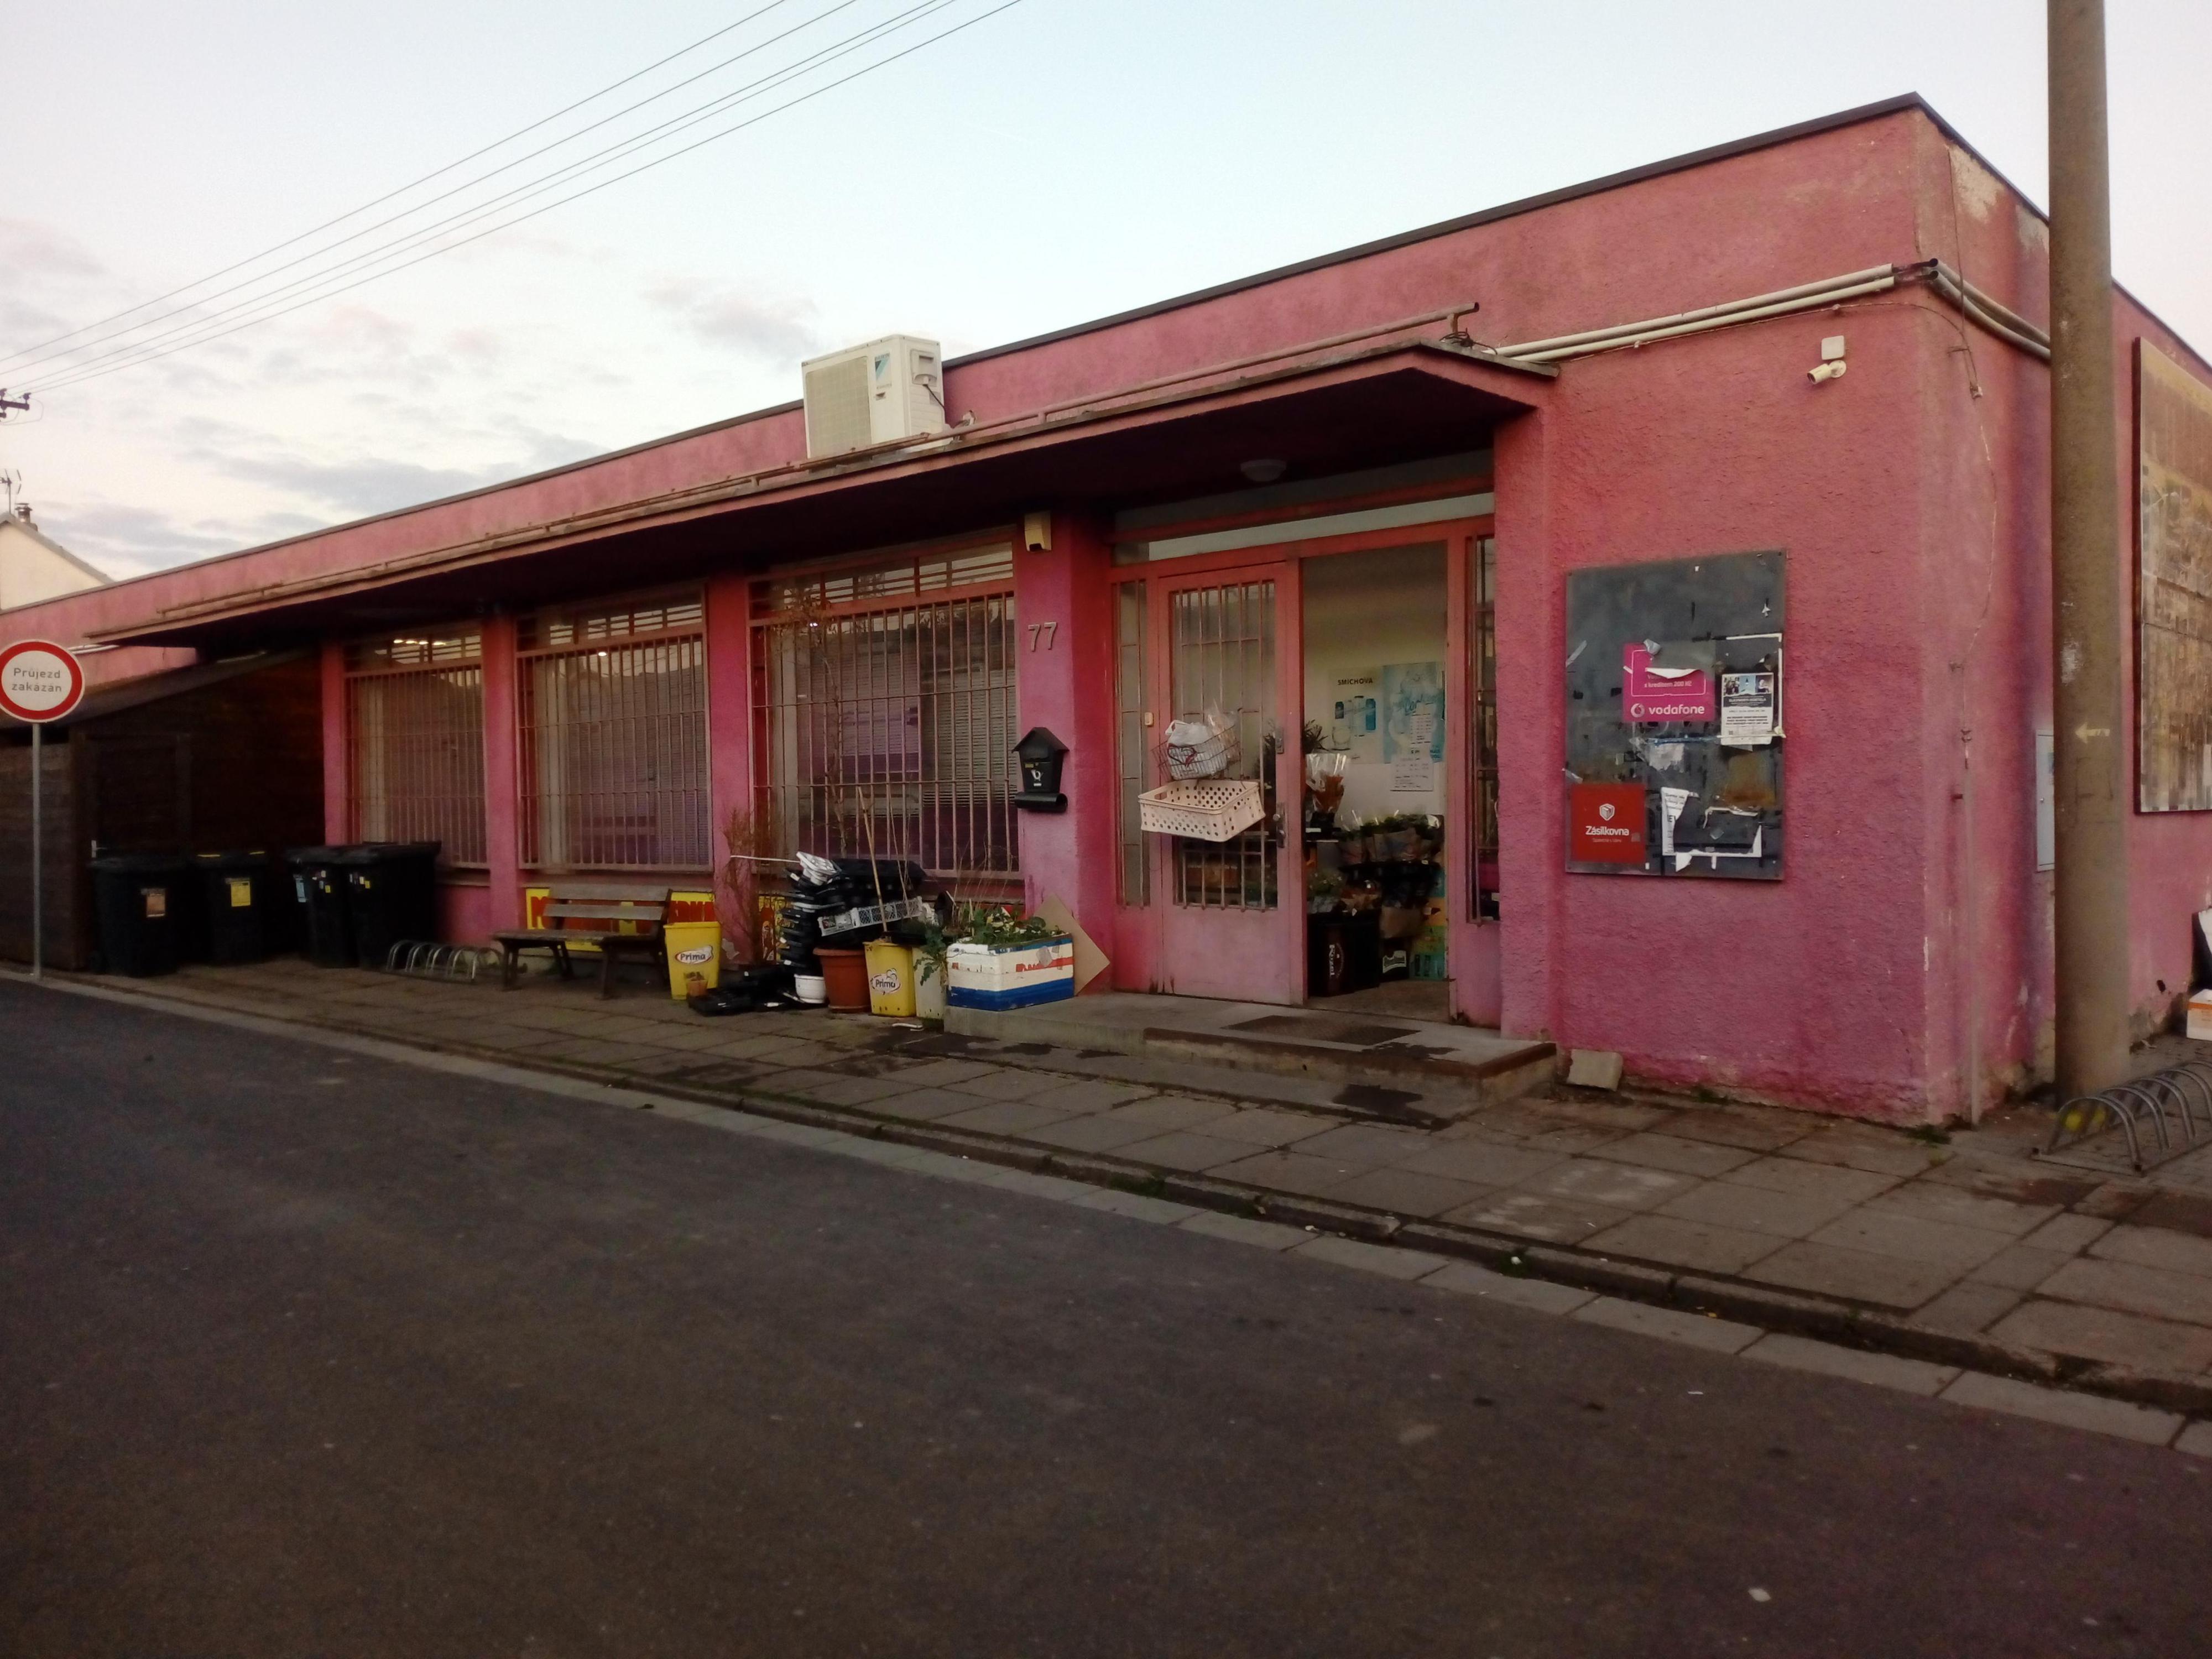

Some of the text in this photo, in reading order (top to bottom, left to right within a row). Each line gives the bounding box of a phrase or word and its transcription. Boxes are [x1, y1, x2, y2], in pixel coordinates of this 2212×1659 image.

[1028, 622, 1057, 652] 77
[13, 667, 60, 680] Průjezd
[12, 682, 62, 692] zakázán
[1648, 704, 1705, 715] vodafone
[1585, 826, 1630, 836] Zásilkovna
